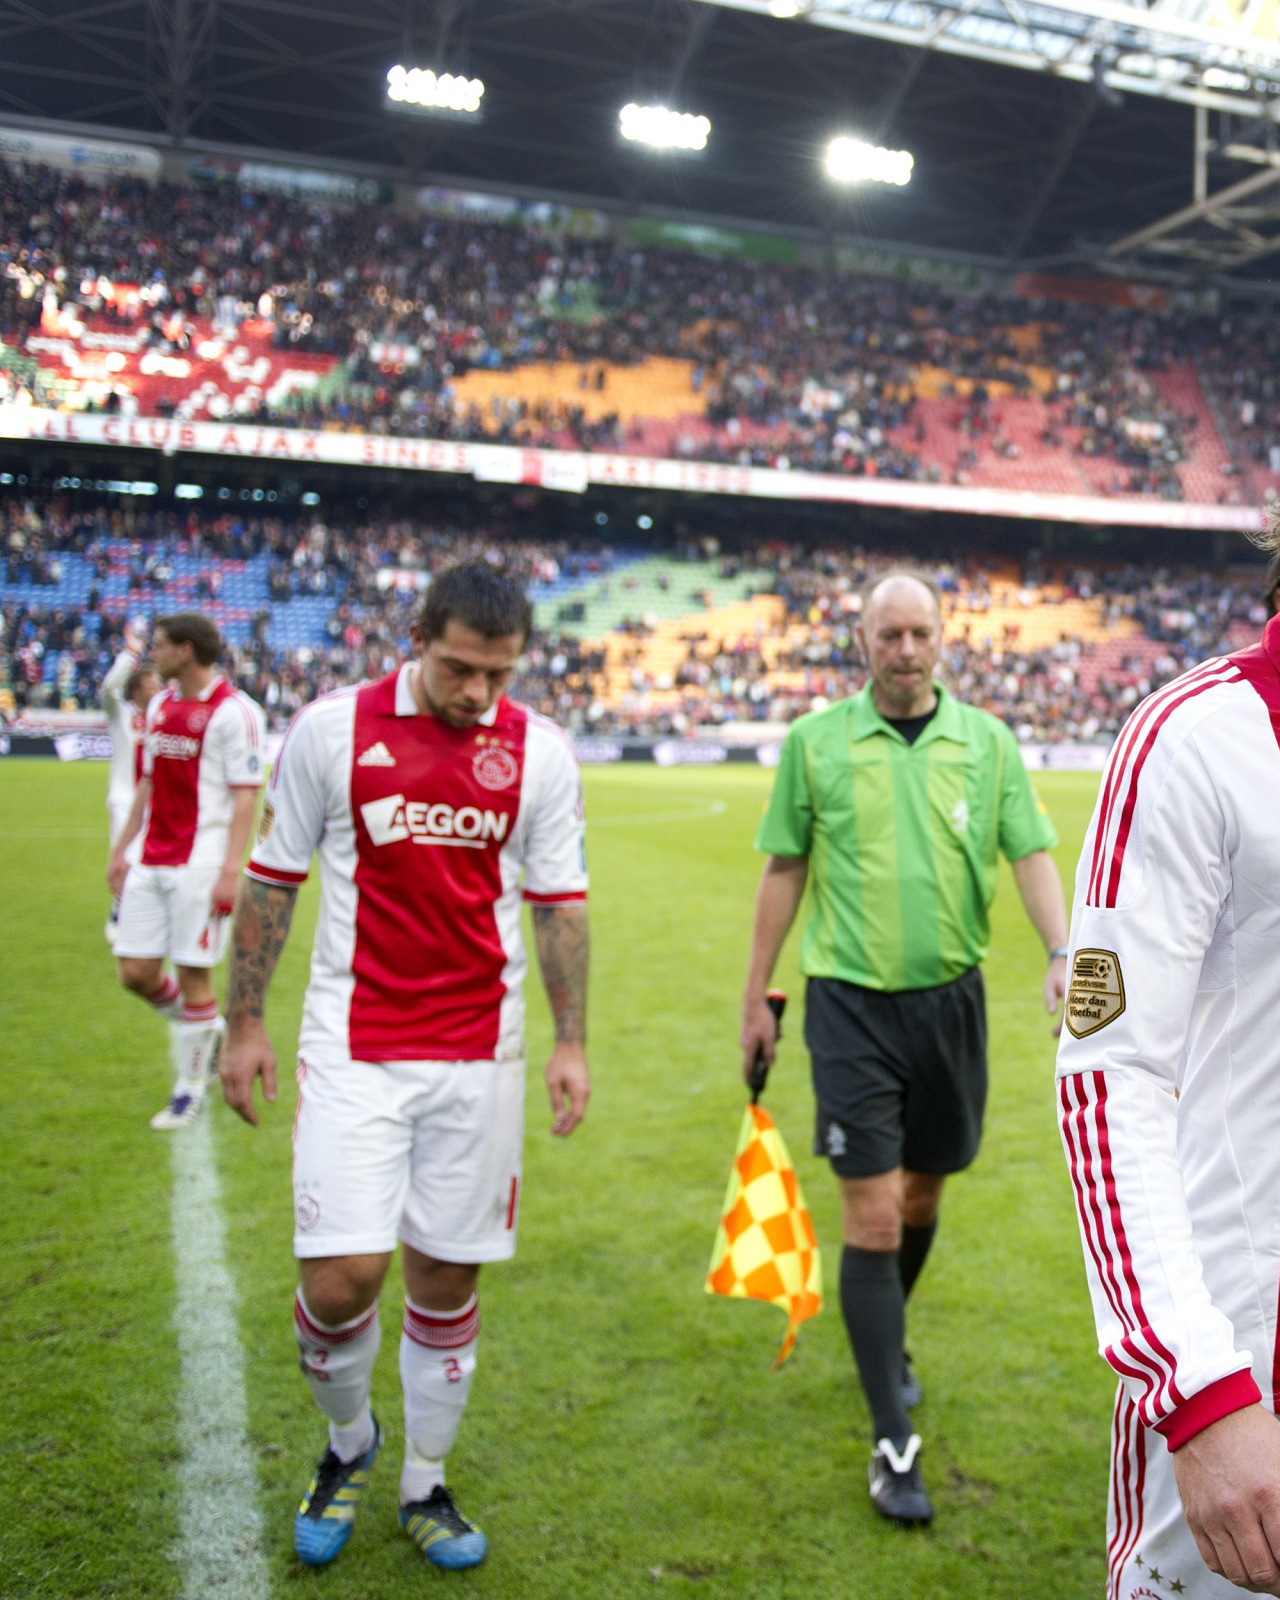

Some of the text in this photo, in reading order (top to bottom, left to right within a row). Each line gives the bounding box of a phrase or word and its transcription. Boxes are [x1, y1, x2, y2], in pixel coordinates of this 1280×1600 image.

[102, 419, 198, 449] CLUB
[219, 427, 322, 461] AJAX
[362, 440, 468, 473] SINDS
[387, 799, 509, 842] AEGON
[1069, 993, 1107, 1007] Meer dan
[1069, 1006, 1101, 1019] Voetbal
